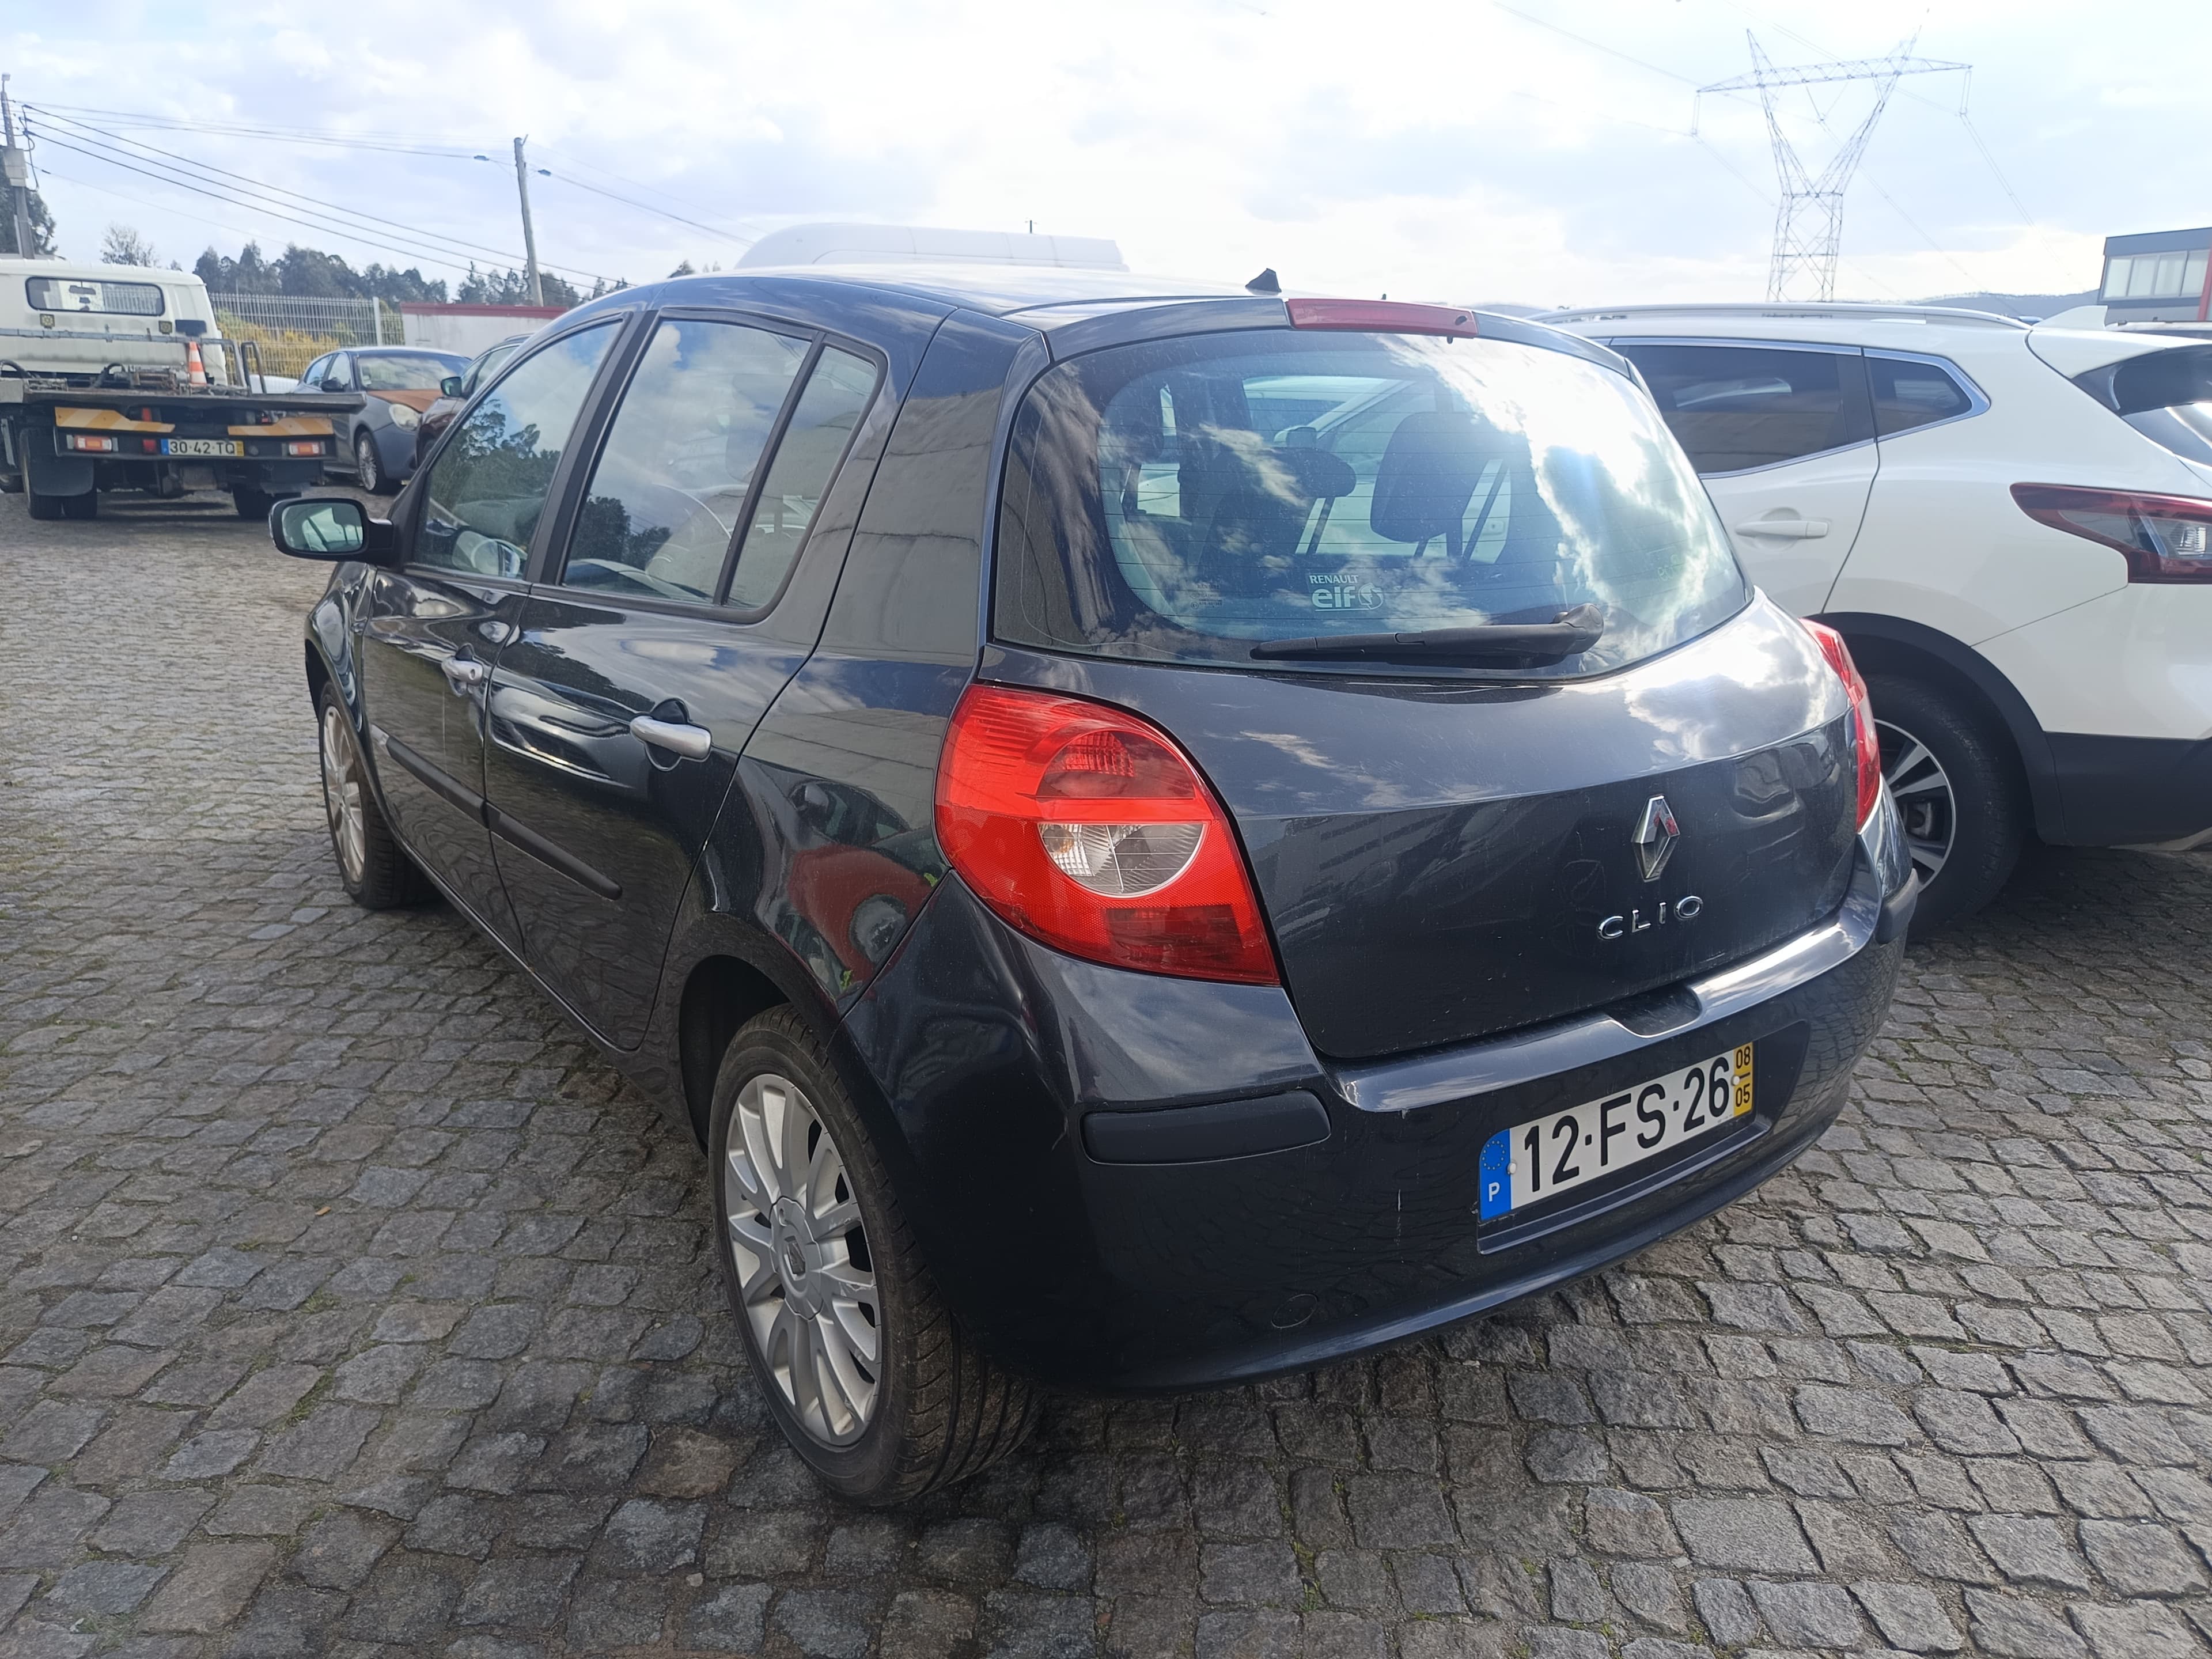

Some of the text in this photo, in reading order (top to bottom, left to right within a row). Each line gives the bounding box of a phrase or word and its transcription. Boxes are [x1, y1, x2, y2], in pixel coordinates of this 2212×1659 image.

[1309, 575, 1359, 584] RENAULT
[1312, 586, 1355, 608] elf
[1598, 895, 1703, 940] CLIO
[1736, 1046, 1751, 1069] 08
[1735, 1083, 1750, 1107] 05
[1488, 1182, 1500, 1202] P
